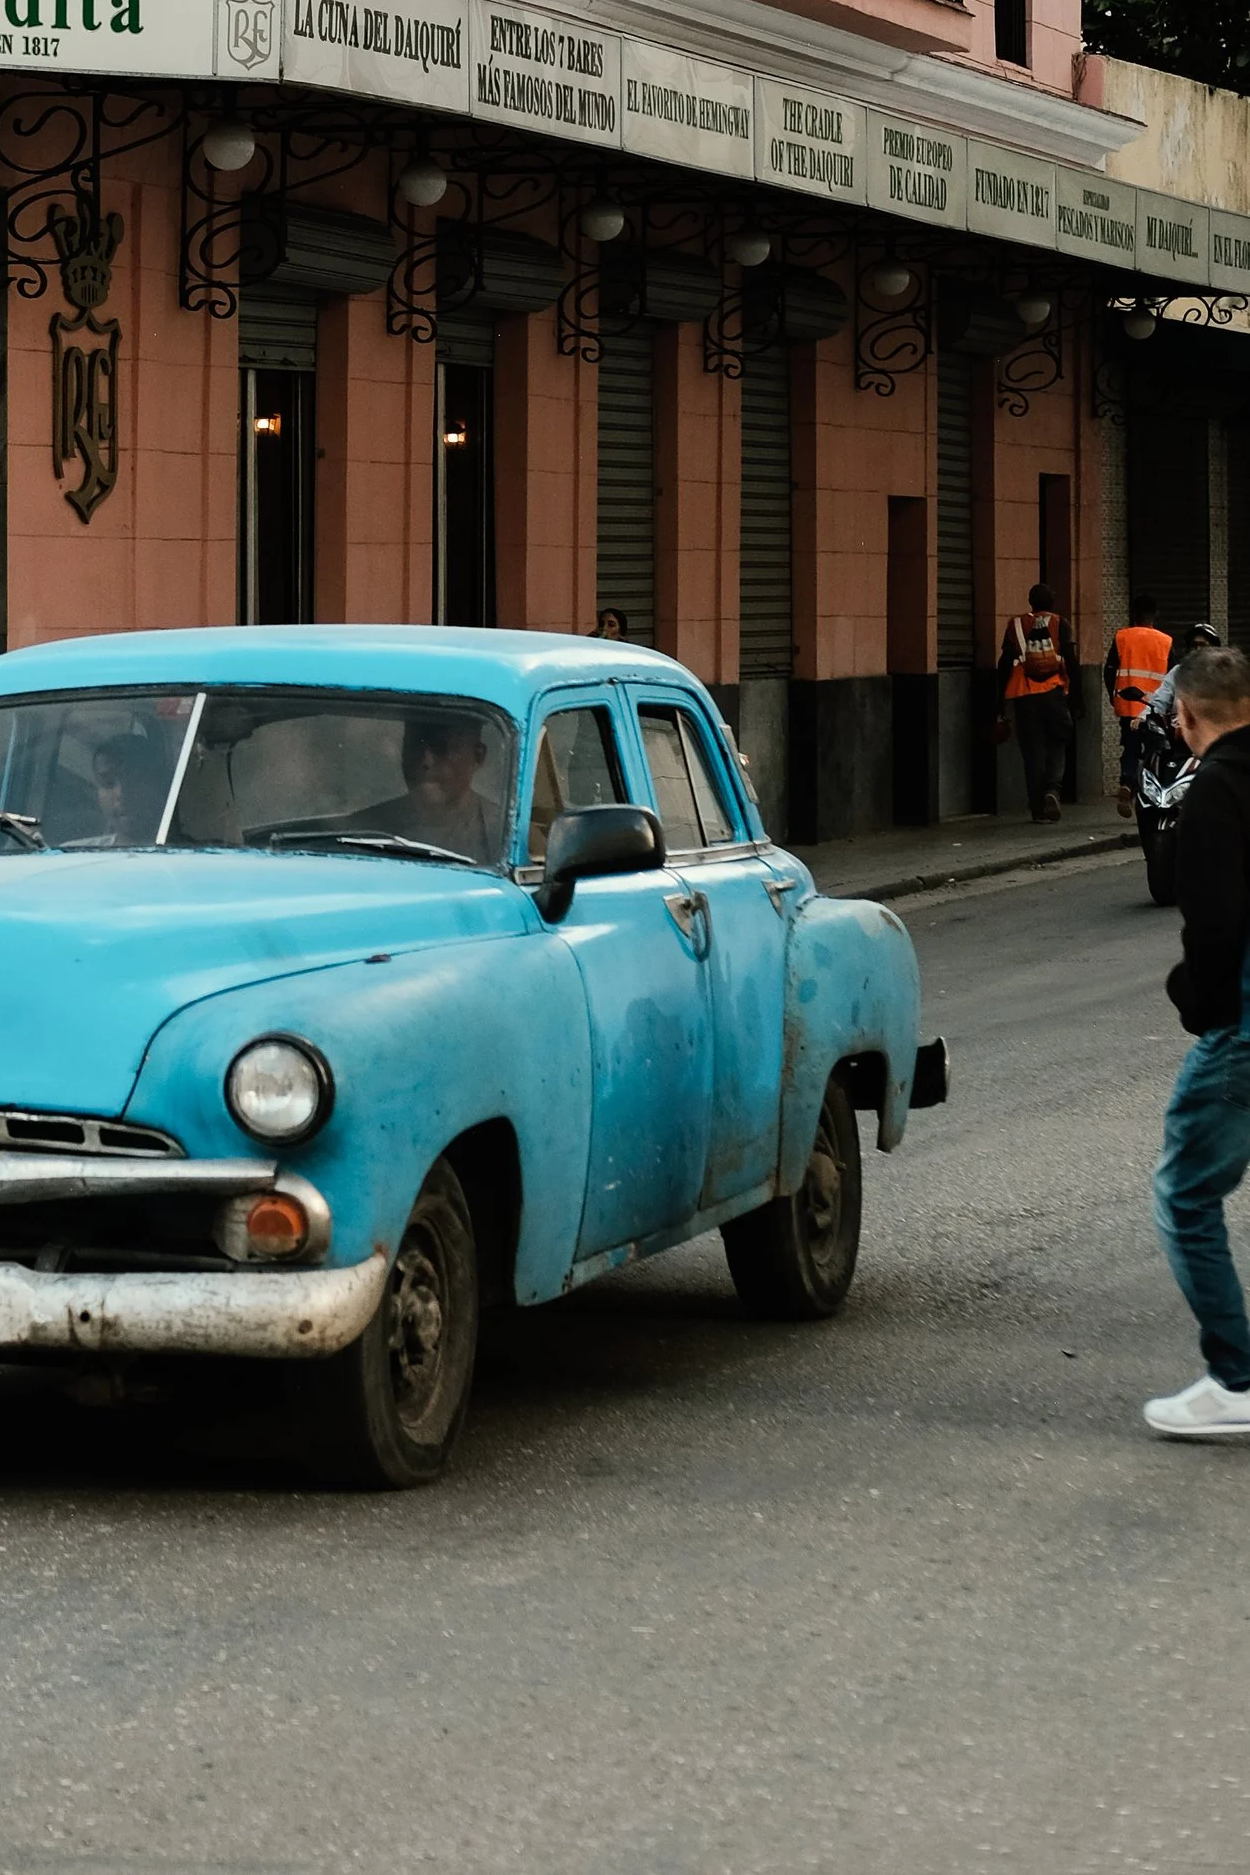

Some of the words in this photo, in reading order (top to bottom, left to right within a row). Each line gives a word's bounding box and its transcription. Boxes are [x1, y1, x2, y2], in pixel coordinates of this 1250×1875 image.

[22, 36, 60, 58] 1817
[363, 8, 391, 55] DEL
[394, 14, 462, 73] DAIQUIRÍ
[490, 14, 532, 59] ENTRE
[534, 26, 556, 66] LOS
[558, 36, 566, 68] 7
[567, 36, 603, 78] BARES
[477, 54, 501, 107] MÁS
[503, 69, 553, 120] FAMOSOS
[555, 84, 577, 125] DEL
[578, 88, 616, 133] MUNDO
[627, 78, 640, 113] EL
[641, 82, 685, 126] FAVORITO
[685, 94, 698, 128] DE
[699, 97, 750, 140] HEMINGWAY
[782, 98, 804, 133] THE
[805, 104, 843, 144] CRADLE
[771, 138, 785, 172] OF
[786, 143, 808, 178] THE
[809, 148, 853, 193] DAIQUIRI
[883, 127, 915, 162] PREMIO
[916, 136, 953, 171] EUROPEO
[889, 165, 903, 201] DE
[905, 170, 947, 211] CALIDAD
[975, 168, 1015, 211] FUNDADO
[1017, 180, 1029, 214] EN
[1030, 183, 1049, 219] 1817
[1058, 205, 1093, 242] PESCADOS
[1093, 216, 1100, 244] Y
[1100, 217, 1134, 253] MARISCOS
[1146, 216, 1158, 248] MI
[1213, 234, 1223, 264] EN
[1223, 236, 1233, 266] EL
[1233, 238, 1250, 271] FLO
